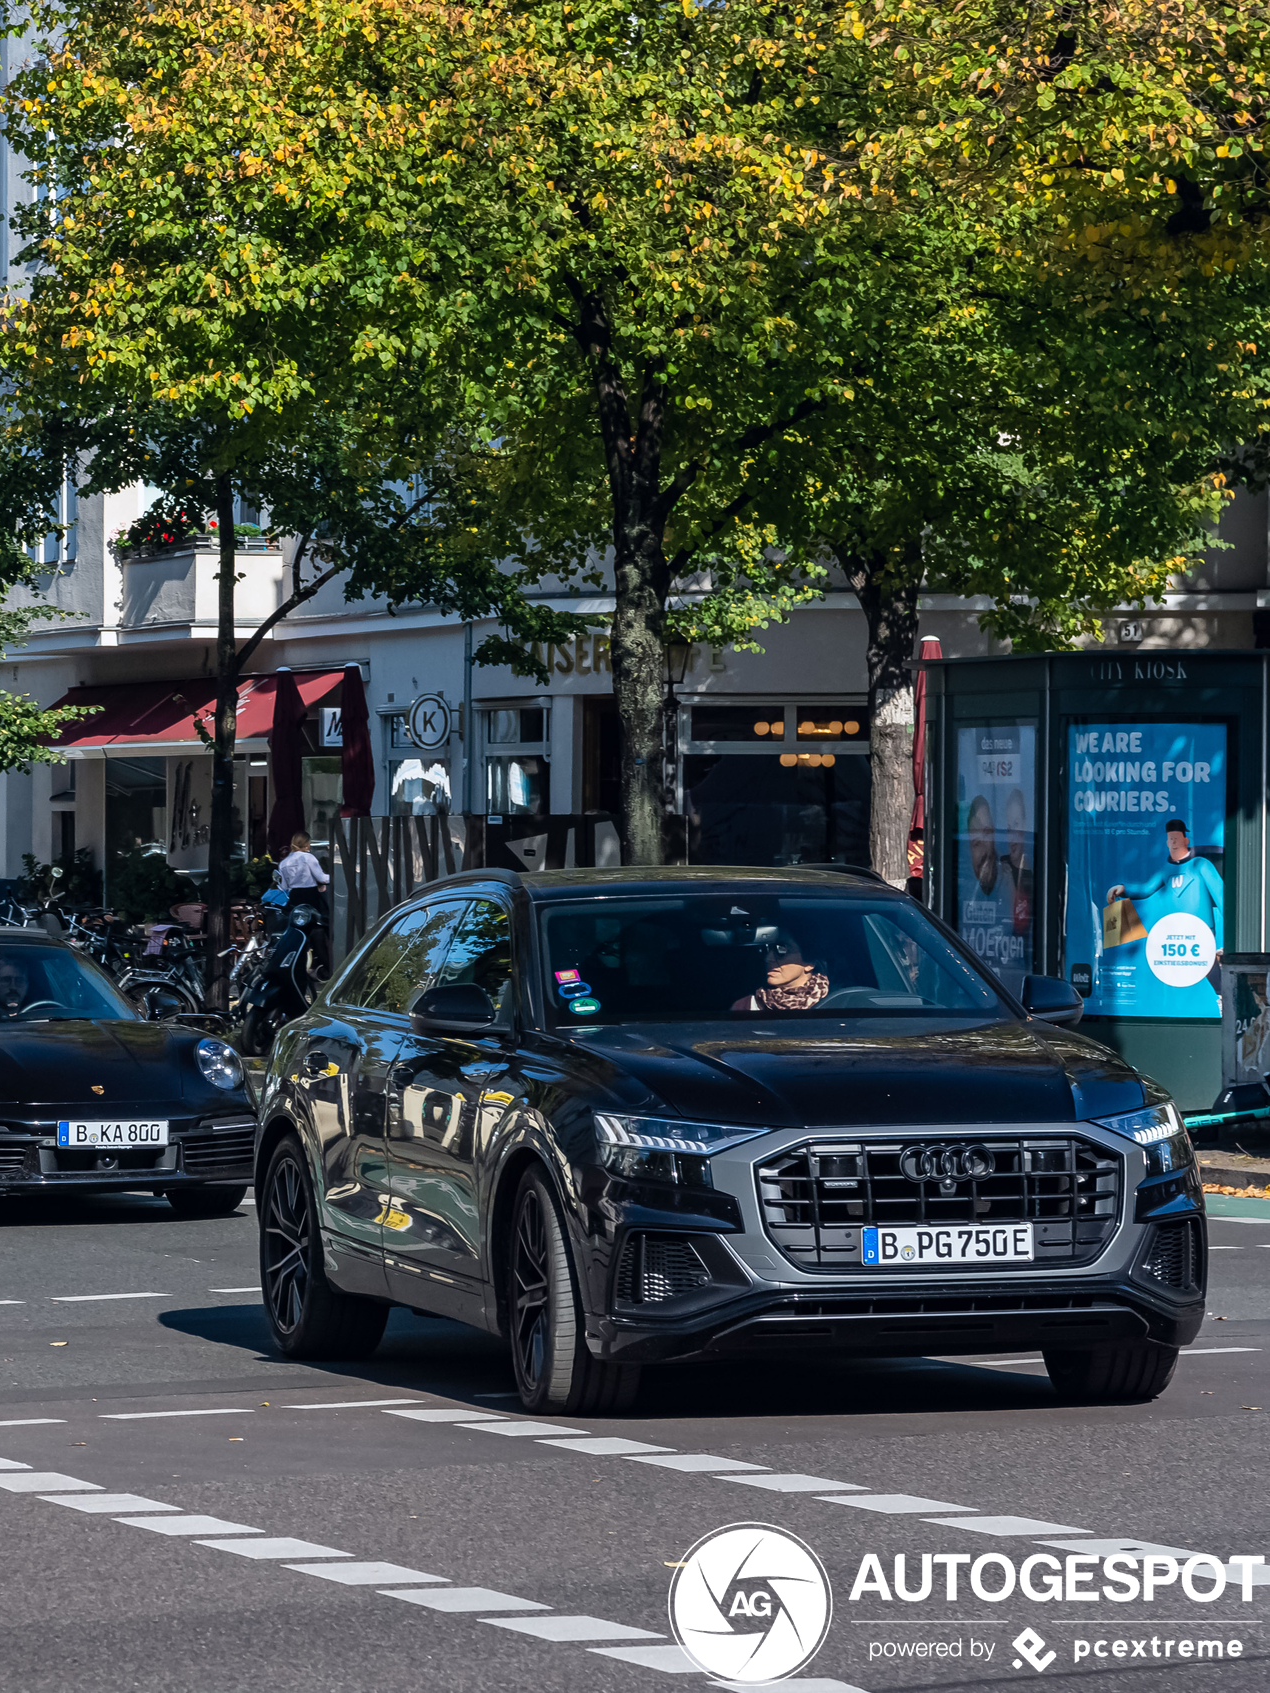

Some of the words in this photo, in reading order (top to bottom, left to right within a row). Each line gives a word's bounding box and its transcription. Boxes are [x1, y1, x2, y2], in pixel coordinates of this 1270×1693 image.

[1124, 625, 1137, 637] 51
[1134, 661, 1188, 680] KIOSK
[422, 711, 437, 733] K
[981, 736, 993, 750] das
[994, 738, 1013, 750] neue
[1075, 732, 1099, 754] WE
[1101, 731, 1143, 754] ARE
[1074, 761, 1157, 783] LOOKING
[1162, 761, 1211, 783] FOR
[1074, 790, 1176, 813] COURIERS.
[1171, 874, 1184, 888] W
[1161, 944, 1187, 957] 150
[1190, 944, 1200, 957] €
[77, 1124, 88, 1142] B
[100, 1124, 123, 1142] KA
[128, 1124, 160, 1142] 800
[881, 1232, 898, 1260] B
[916, 1230, 952, 1259] PG
[957, 1228, 1030, 1258] 750E
[867, 1250, 875, 1259] D
